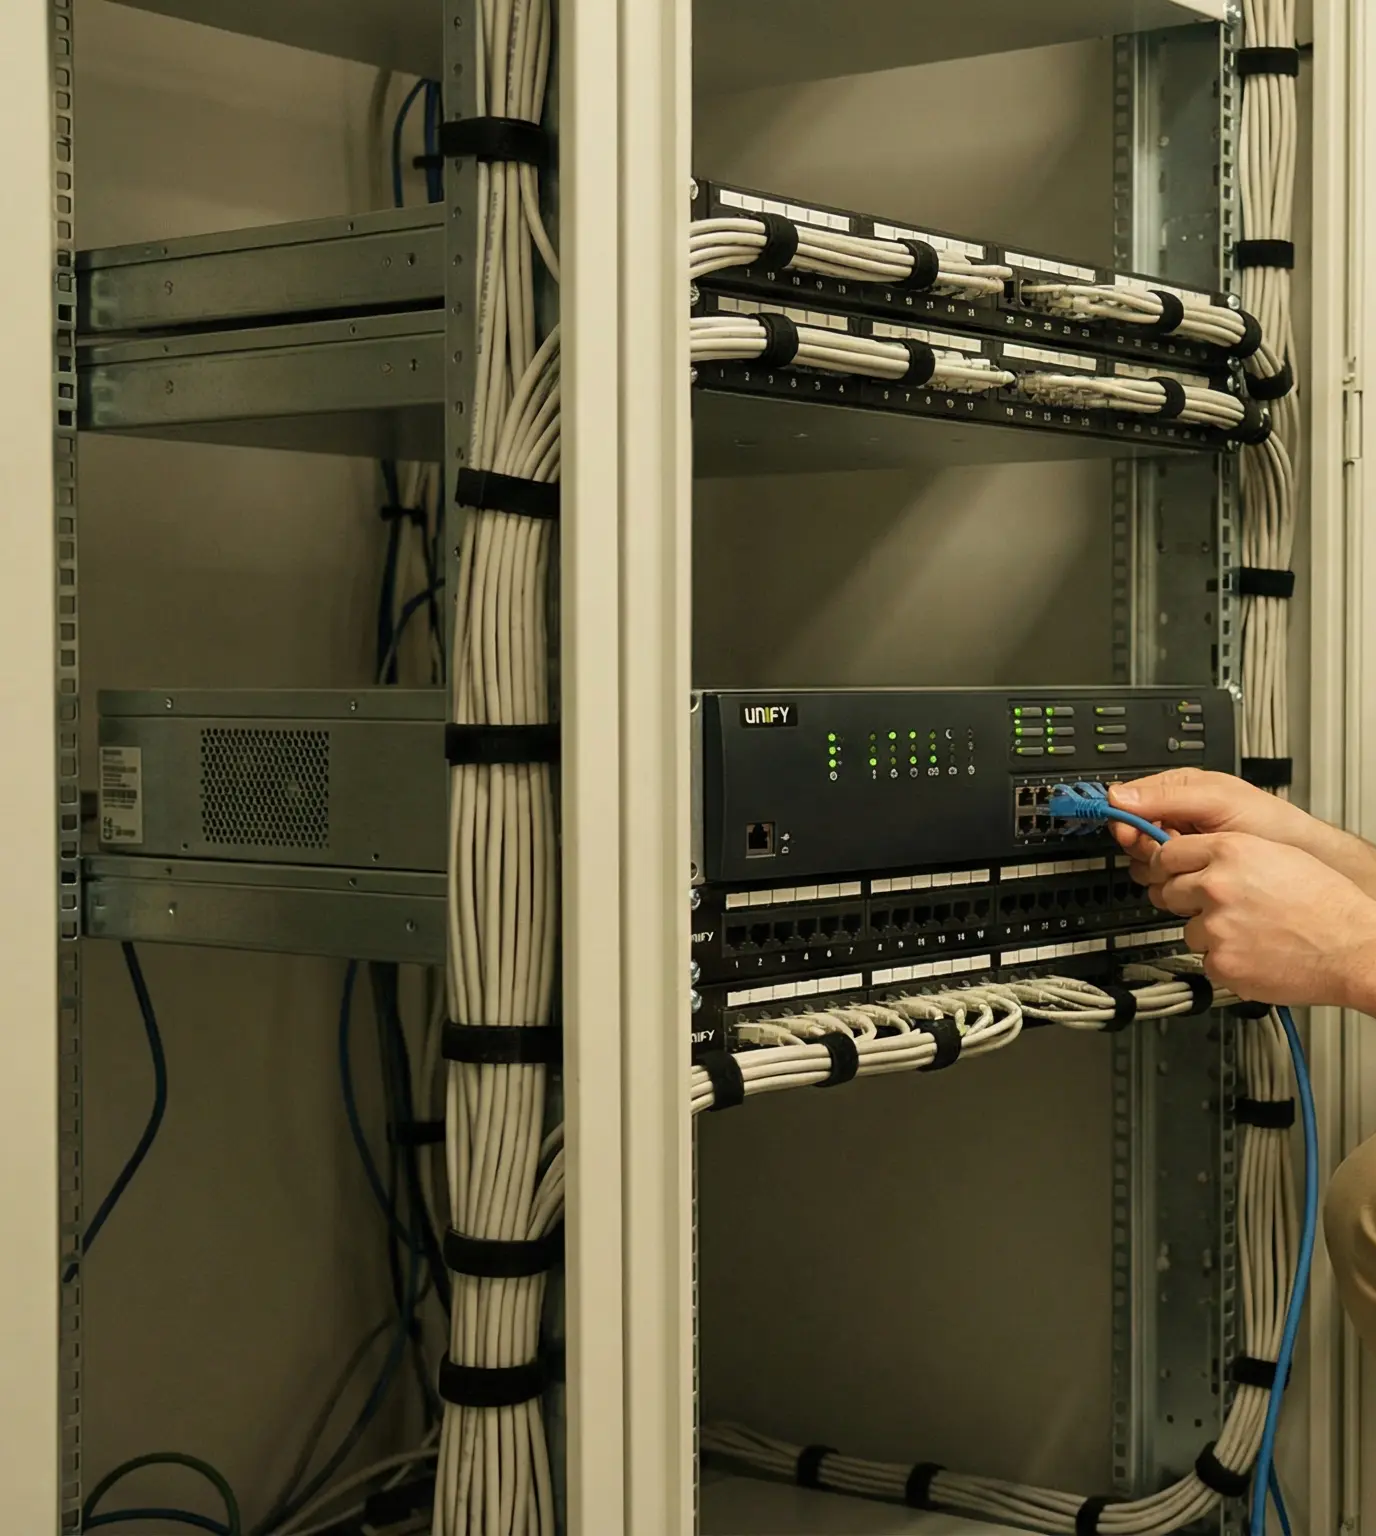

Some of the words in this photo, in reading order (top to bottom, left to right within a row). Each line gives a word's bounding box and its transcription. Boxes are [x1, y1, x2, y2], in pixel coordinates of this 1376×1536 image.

[720, 369, 724, 378] 1
[745, 372, 750, 381] 2
[905, 393, 910, 401] 7
[744, 706, 790, 724] UNIFY
[758, 958, 763, 966] 2
